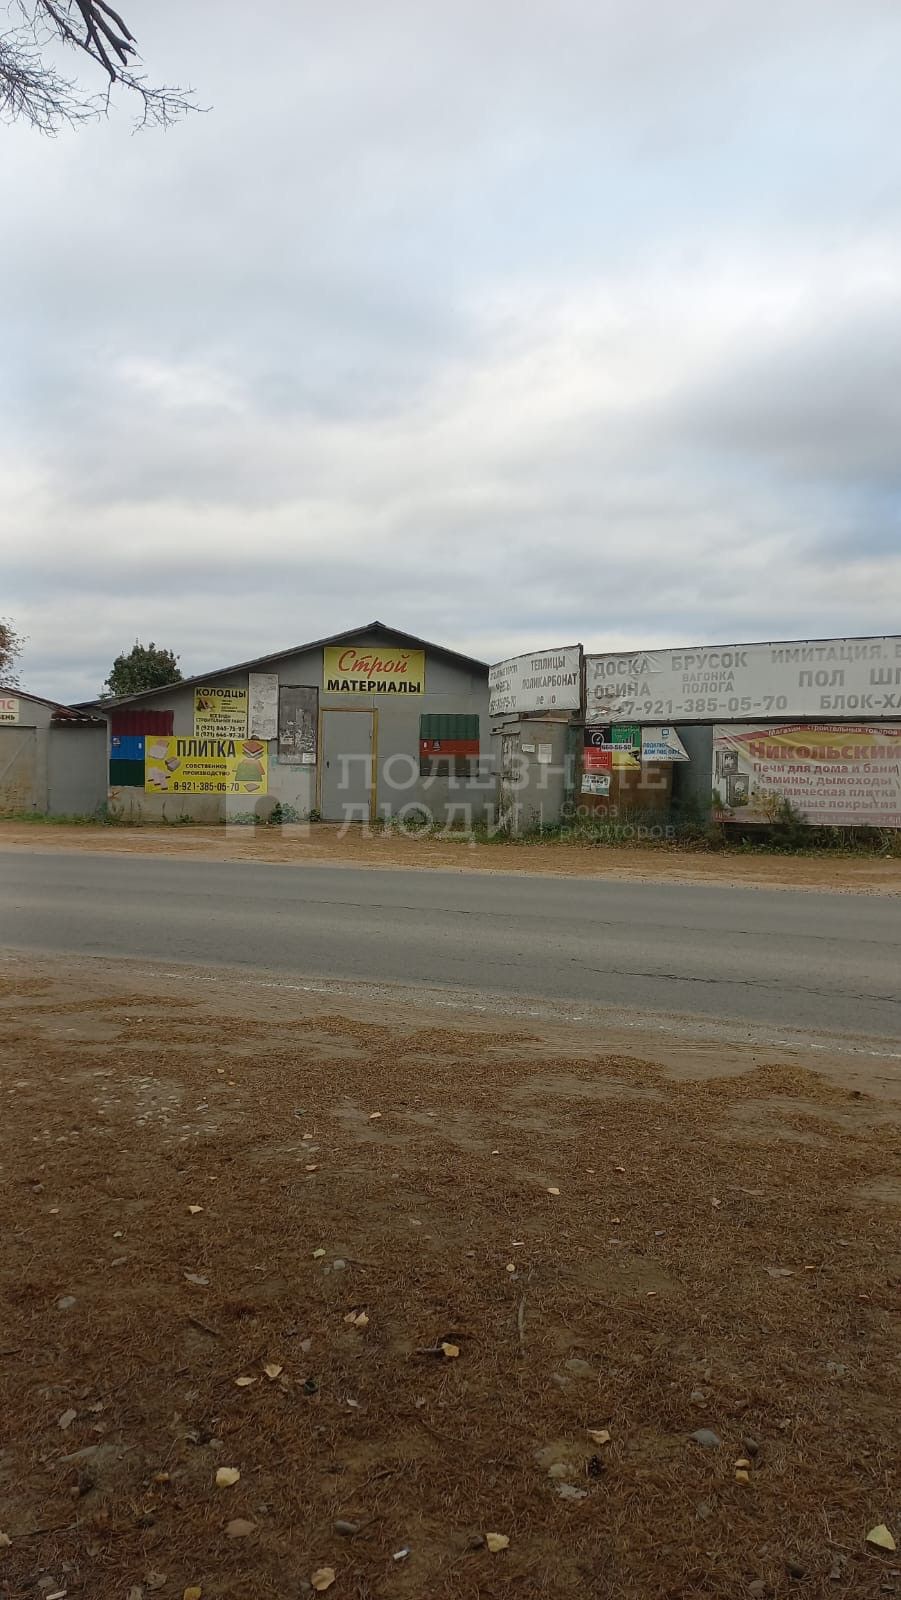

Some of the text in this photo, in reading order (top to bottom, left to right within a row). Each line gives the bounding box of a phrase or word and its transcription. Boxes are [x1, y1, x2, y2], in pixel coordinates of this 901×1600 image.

[338, 649, 410, 679] Строй
[531, 656, 566, 671] ТЕПЛИЦЫ
[671, 652, 748, 671] БРУСОК
[594, 659, 650, 679] ДОСКА
[522, 672, 578, 690] ПОЛИКАРБОНАТ
[682, 671, 735, 682] ВАГОНКА
[799, 669, 845, 687] ПОЛ
[327, 680, 421, 693] МАТЕРИАЛЫ
[595, 682, 651, 699] ОСИНА
[682, 682, 735, 694] ПОЛОГА
[196, 689, 246, 698] КОЛОДЦЫ
[768, 725, 801, 737] Магазин
[176, 739, 236, 758] ПЛИТКА
[753, 763, 897, 774] Печи для дома и бани
[174, 781, 240, 792] 8-921-385-05-70
[757, 775, 892, 787] Камины, дымоходы
[849, 787, 897, 798] плитка
[829, 800, 897, 811] покрытия
